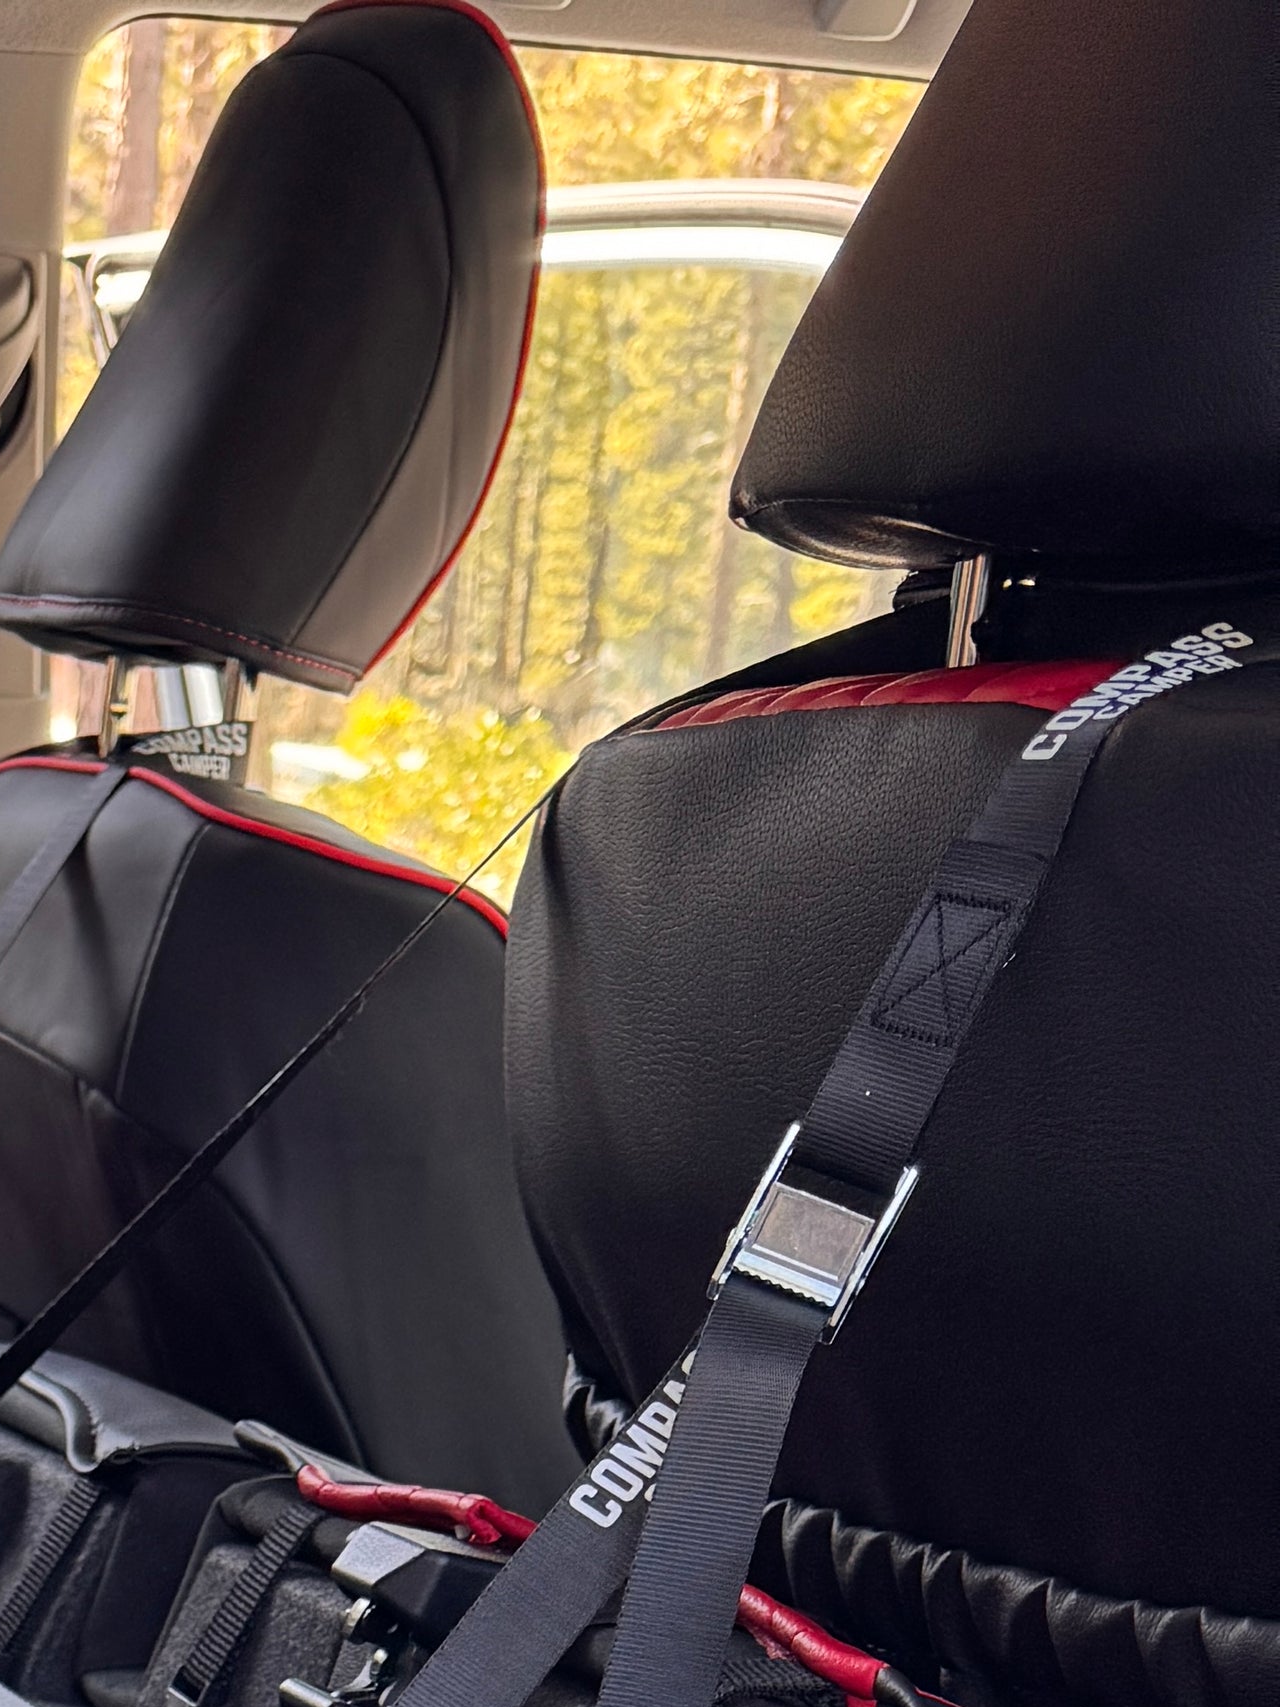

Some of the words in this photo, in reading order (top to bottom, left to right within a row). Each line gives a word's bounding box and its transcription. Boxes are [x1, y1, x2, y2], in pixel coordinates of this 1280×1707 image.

[1021, 621, 1254, 761] COMPASS
[1092, 654, 1244, 721] CAMPER
[131, 722, 248, 757] COMPASS
